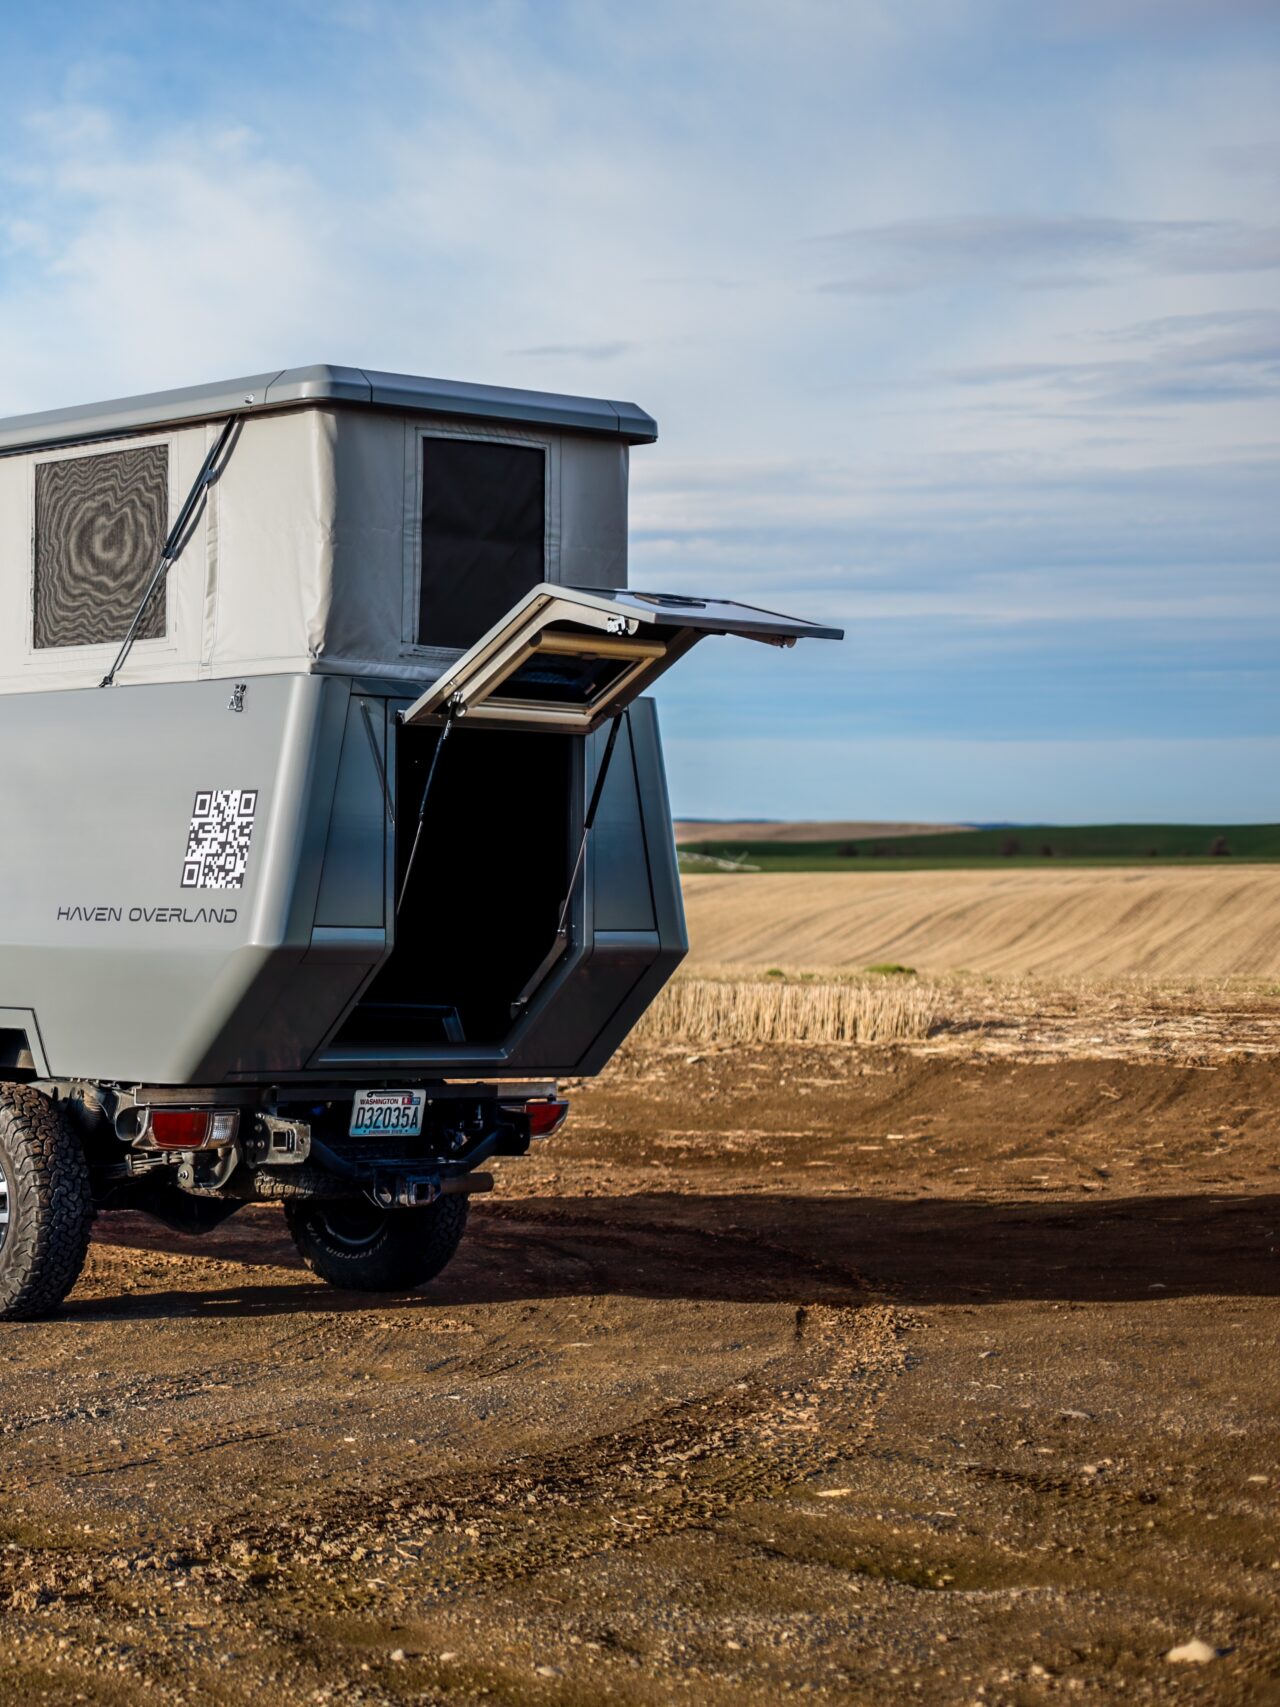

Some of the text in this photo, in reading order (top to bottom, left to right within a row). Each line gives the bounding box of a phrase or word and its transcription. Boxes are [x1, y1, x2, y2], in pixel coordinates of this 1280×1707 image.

[57, 906, 238, 924] HAVEN OVERLAND
[355, 1106, 419, 1129] D32035A
